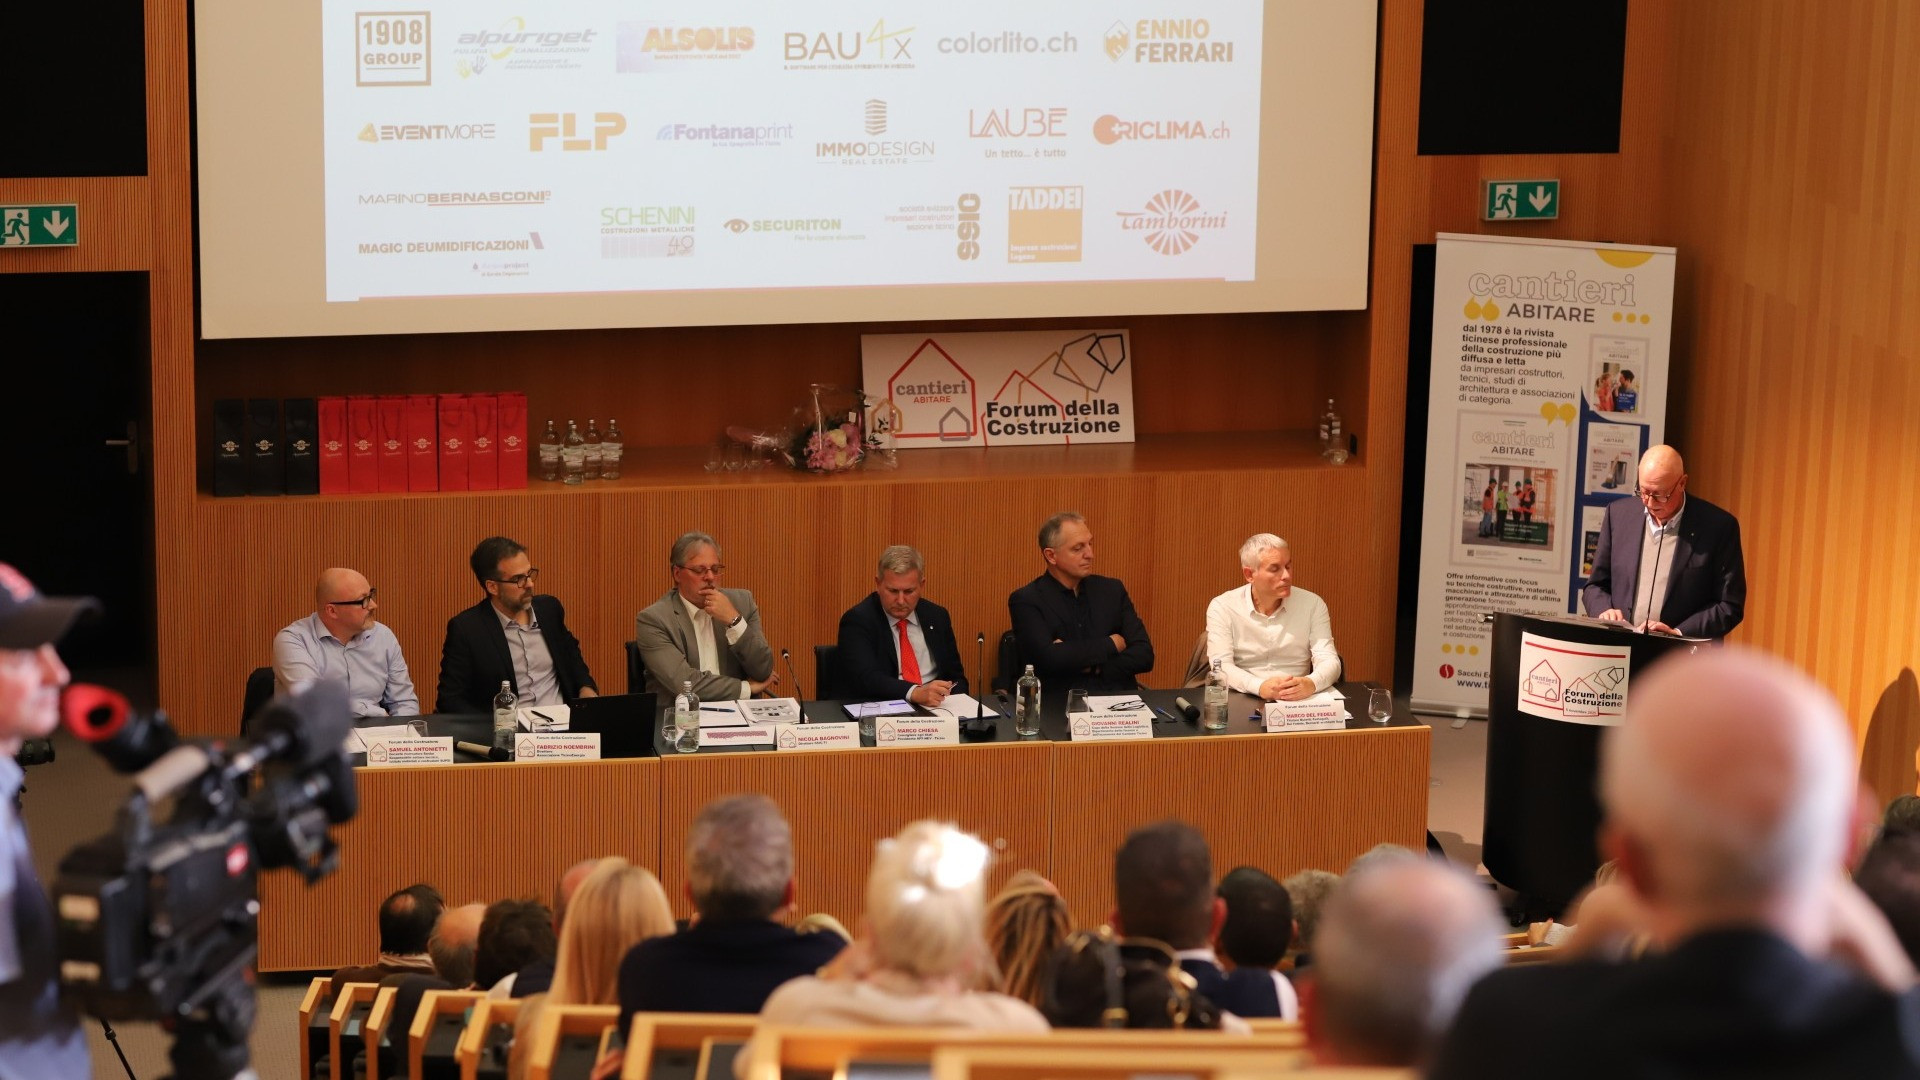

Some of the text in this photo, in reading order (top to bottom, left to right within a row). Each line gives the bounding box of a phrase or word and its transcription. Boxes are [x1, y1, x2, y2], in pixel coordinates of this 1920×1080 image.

[363, 19, 423, 46] 1908
[1135, 18, 1210, 40] ENNIO
[457, 29, 598, 48] alpuriget
[640, 27, 755, 52] ALSOLIS
[937, 31, 1077, 54] colorlito.ch
[363, 52, 423, 65] GROUP
[1135, 41, 1233, 63] FERRARI
[380, 123, 496, 141] EVENTMORE
[529, 112, 627, 152] FLP
[673, 123, 793, 143] Fontanaprint
[816, 141, 935, 157] IMMODESIGN
[985, 149, 997, 158] Un
[1044, 148, 1066, 158] tutto
[871, 157, 908, 165] ESTATE
[1009, 187, 1082, 210] TADDEI
[600, 206, 695, 226] SCHENINI
[1116, 210, 1228, 230] Tamborini
[752, 218, 841, 231] SECURITON
[358, 239, 529, 254] MAGIC DEUMIDIFICAZIONI
[1468, 269, 1636, 307] cantieri
[1507, 303, 1596, 323] ABITARE
[1463, 324, 1478, 332] dal
[1480, 326, 1502, 334] 1978
[1514, 327, 1522, 336] la
[1524, 328, 1554, 338] rivista
[1462, 334, 1568, 349] ticinese professionale
[1462, 344, 1562, 360] della costruzione più
[1461, 354, 1494, 364] diffusa
[1505, 357, 1526, 366] letta
[1460, 364, 1565, 380] da impresari costruttori,
[1460, 374, 1526, 386] tecnici, studi di
[896, 380, 968, 396] cantieri
[1460, 384, 1510, 394] architettura
[1520, 388, 1576, 399] associazioni
[913, 395, 951, 404] ABITARE
[1458, 394, 1513, 406] di categoria.
[986, 399, 1120, 418] Forum della
[986, 419, 1121, 436] Costruzione
[1472, 430, 1555, 449] cantieri
[1491, 446, 1535, 456] ABITARE
[1446, 572, 1464, 580] Offre
[1465, 574, 1504, 583] informative
[1520, 578, 1538, 586] focus
[1446, 588, 1484, 596] macchinari
[1490, 591, 1530, 600] attrezzature
[1486, 584, 1525, 592] costruttive,
[1526, 586, 1558, 595] materiali,
[1444, 602, 1496, 611] approfondimenti
[1488, 598, 1516, 606] fornendo
[1455, 624, 1477, 632] settore
[1457, 670, 1482, 678] Sacchi
[1531, 674, 1558, 685] cantieri
[1565, 688, 1623, 700] Forum della
[1564, 696, 1623, 708] Costruzione
